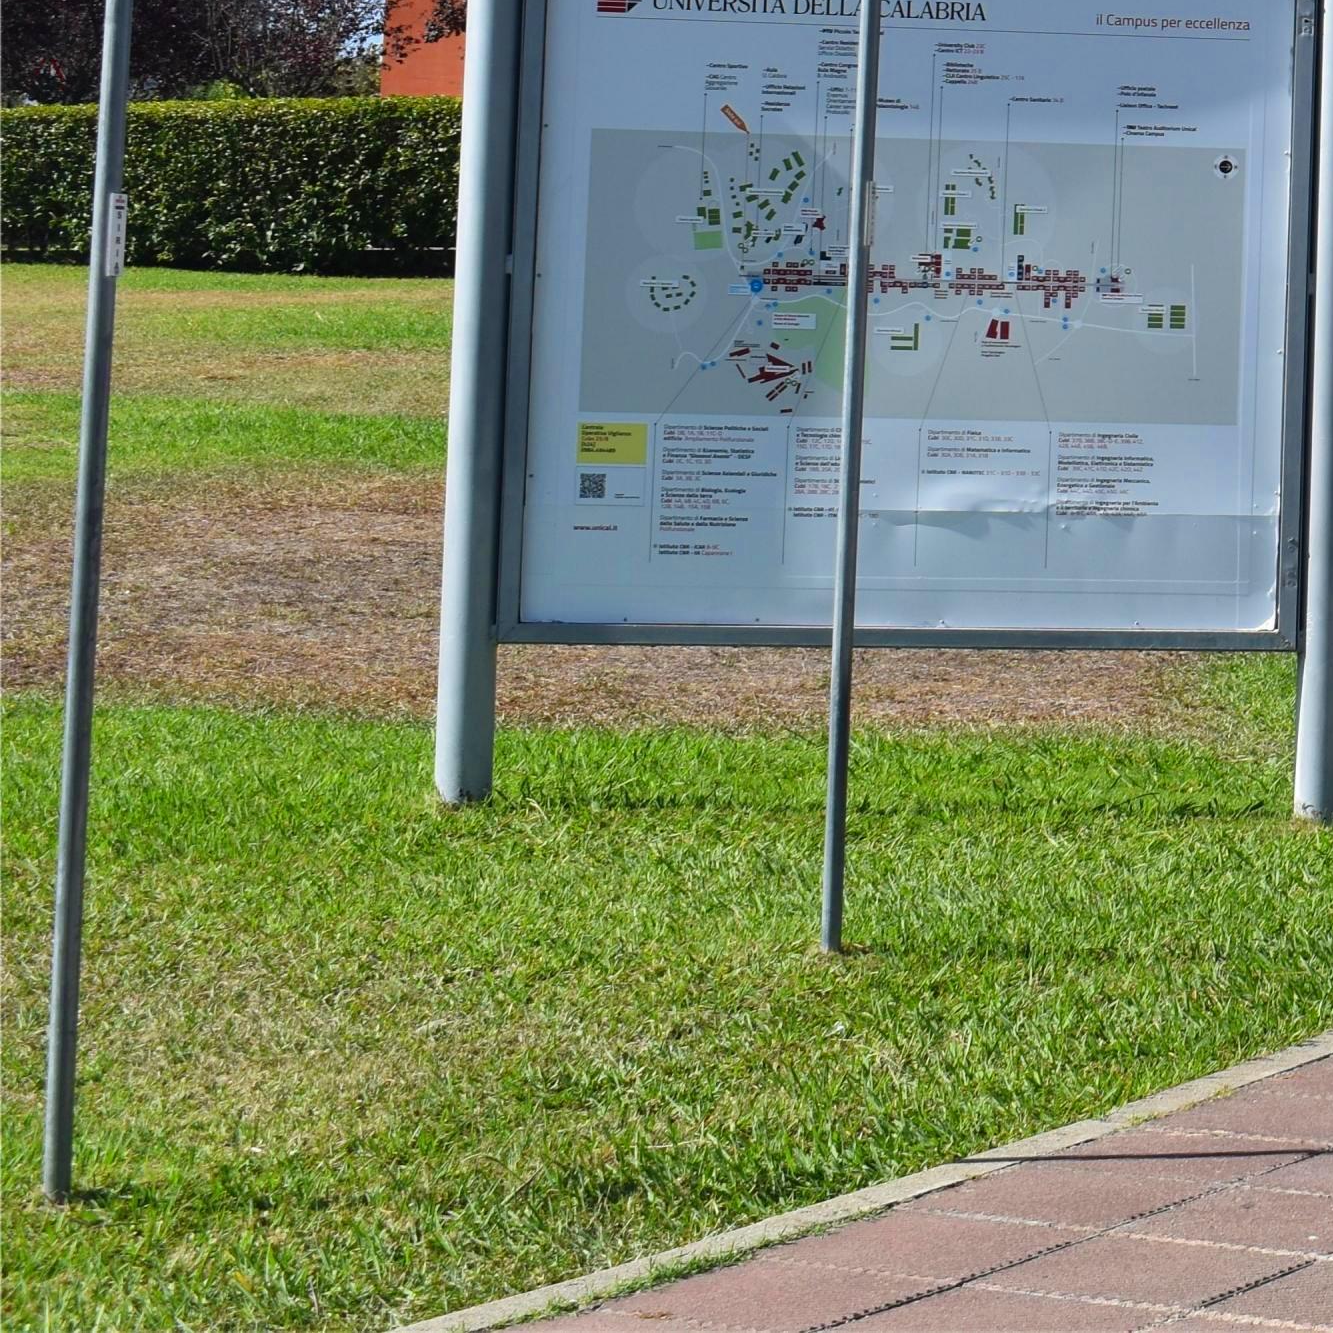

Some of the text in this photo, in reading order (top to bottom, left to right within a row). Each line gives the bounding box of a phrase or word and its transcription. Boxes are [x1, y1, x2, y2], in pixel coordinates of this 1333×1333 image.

[1096, 14, 1250, 31] il Campus per eccellenza
